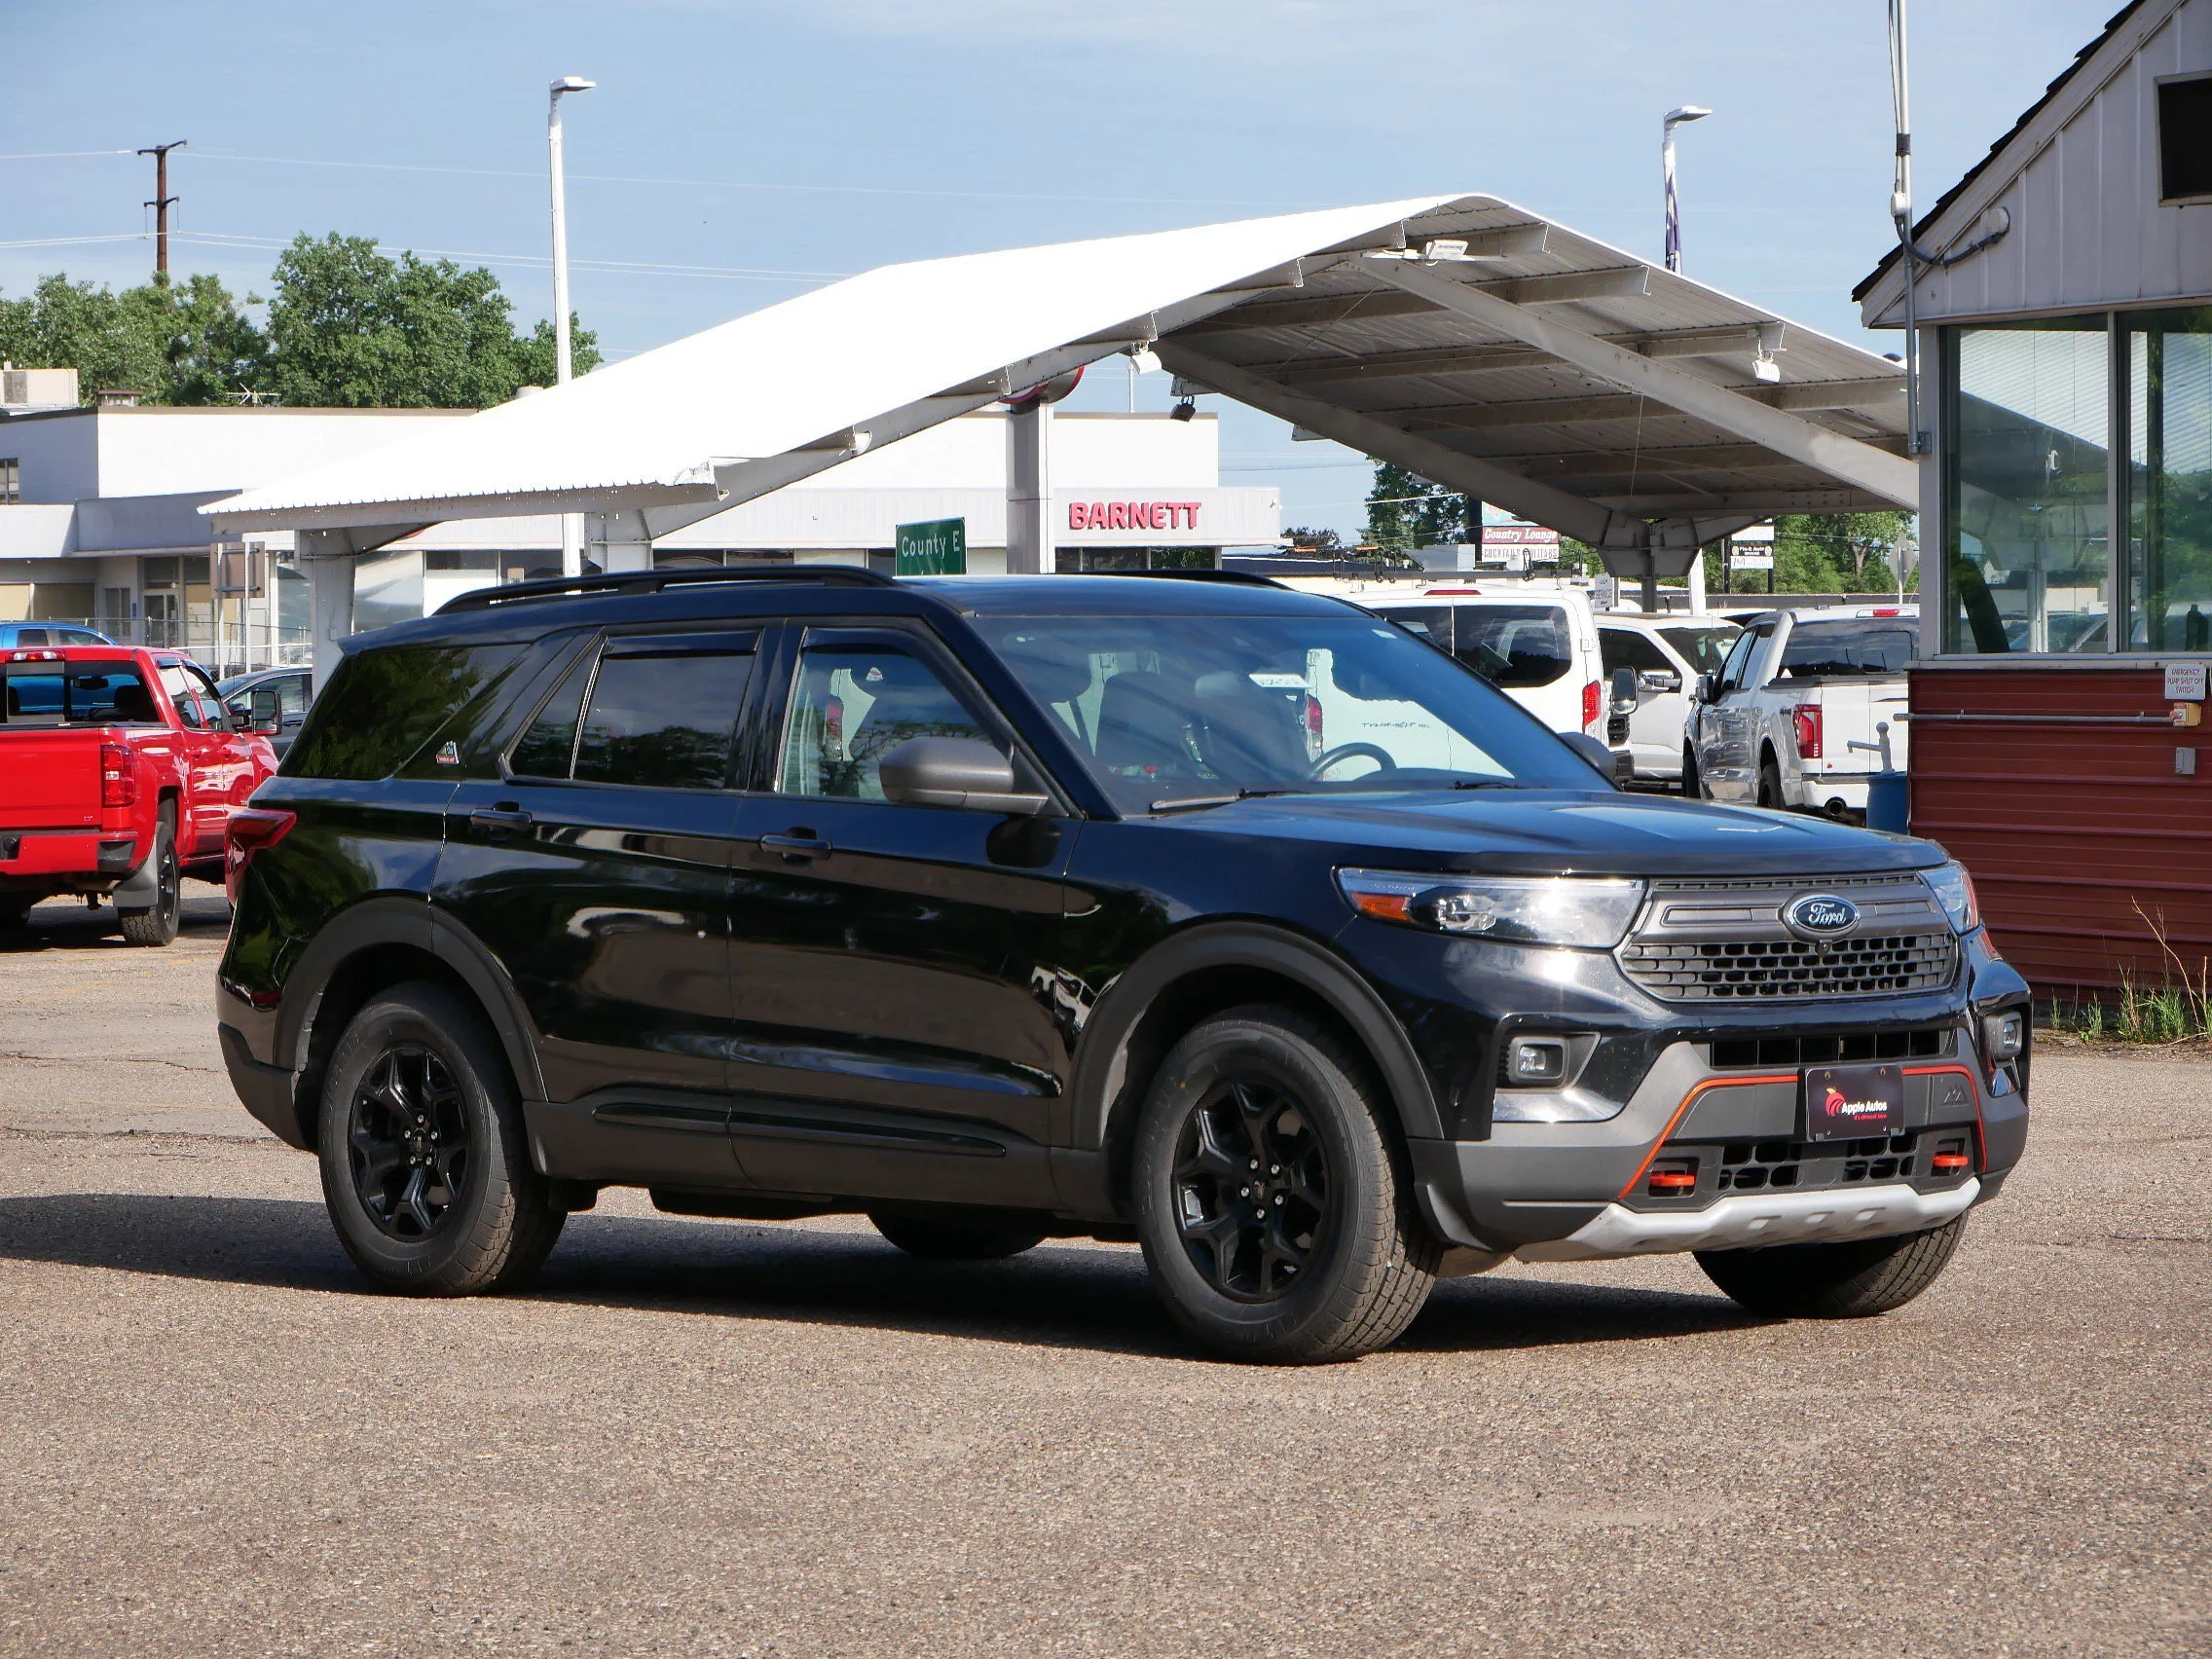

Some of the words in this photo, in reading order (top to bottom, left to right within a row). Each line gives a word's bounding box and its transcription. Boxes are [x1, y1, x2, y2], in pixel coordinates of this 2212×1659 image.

[1069, 501, 1201, 530] BARNETT
[1485, 528, 1522, 542] Country
[1524, 528, 1558, 543] Lounge
[902, 535, 946, 559] County
[952, 530, 961, 552] E
[2171, 668, 2200, 677] EMERGENCY
[2175, 685, 2194, 694] SWITCH
[1808, 903, 1847, 926] Ford
[1841, 1101, 1865, 1116] Apple
[1865, 1100, 1888, 1113] Autos
